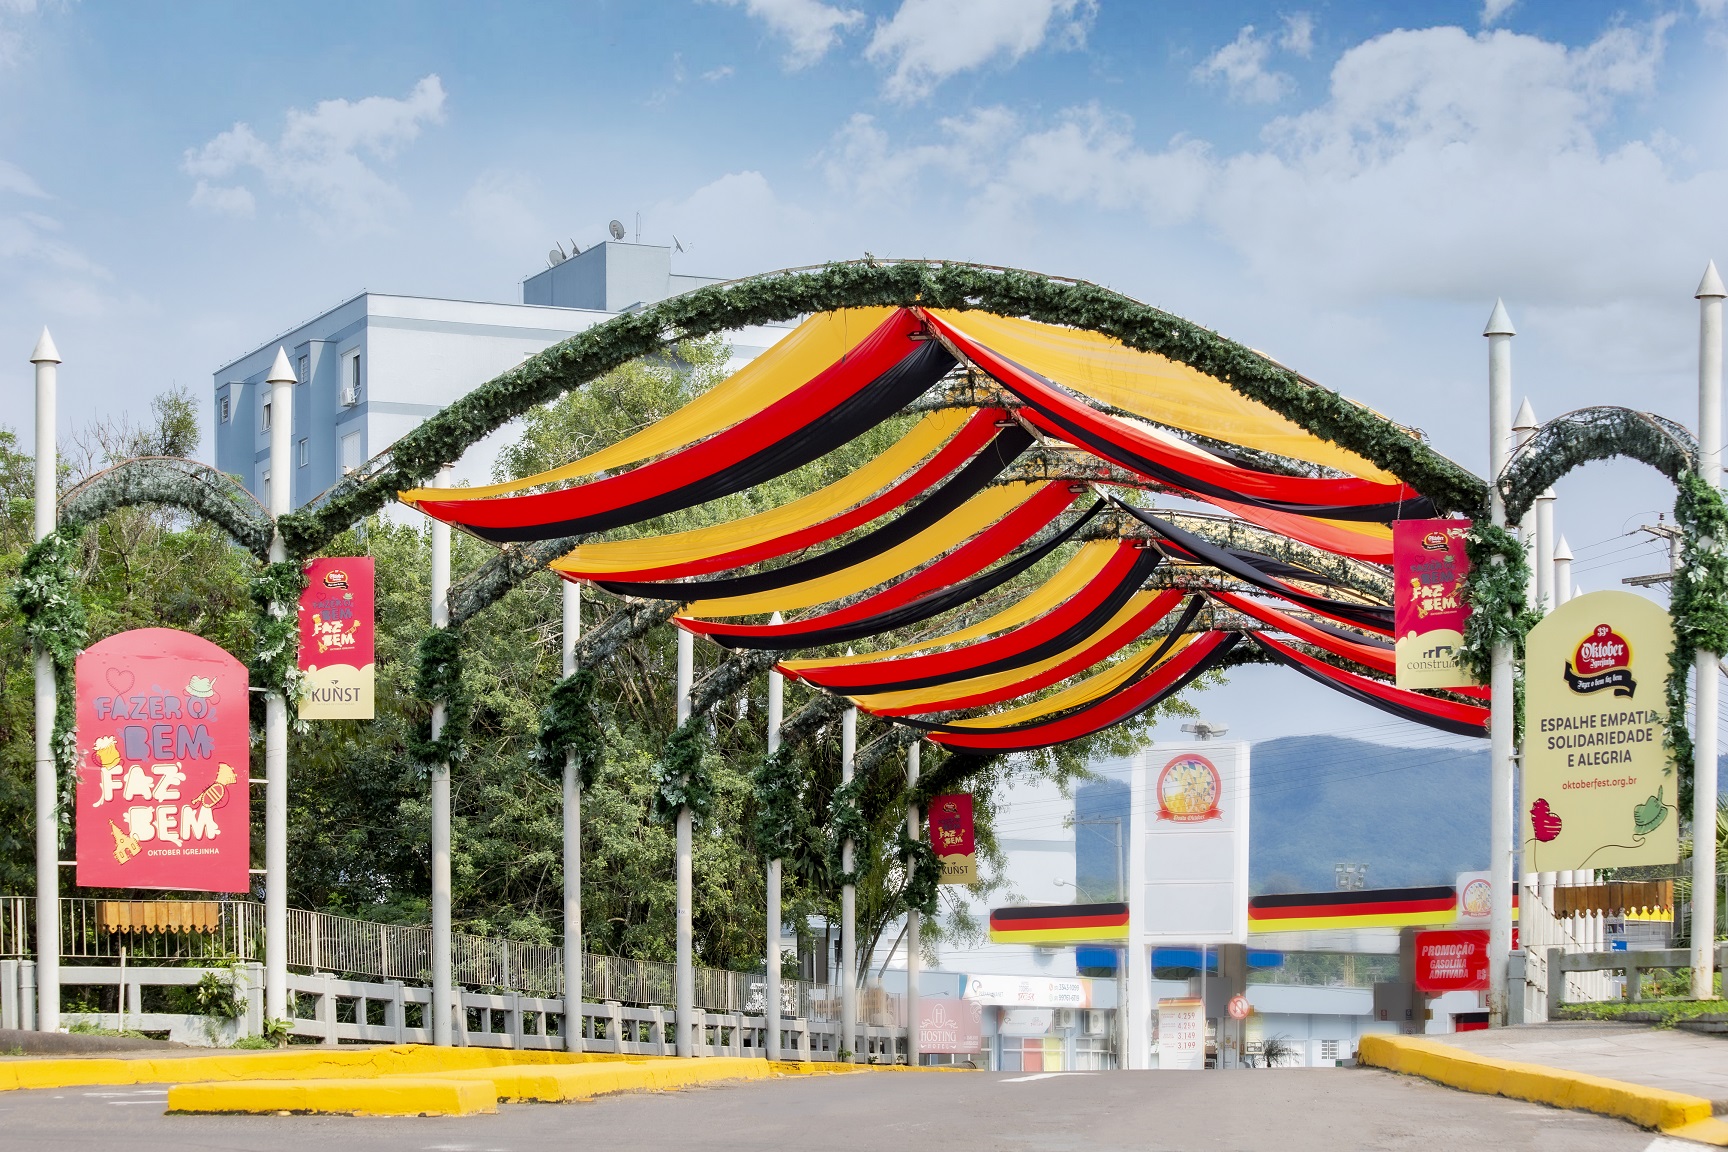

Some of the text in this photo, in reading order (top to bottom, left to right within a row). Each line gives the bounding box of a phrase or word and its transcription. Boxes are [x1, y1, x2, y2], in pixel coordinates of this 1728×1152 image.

[1410, 561, 1443, 573] FAZER
[1420, 570, 1455, 585] BEM
[1411, 584, 1445, 600] FAZ
[313, 599, 342, 609] FAZER
[1421, 597, 1458, 611] BEM
[321, 608, 353, 621] BEM
[313, 621, 344, 635] FAZ
[321, 633, 356, 646] BEM
[1581, 641, 1624, 662] Oktober
[96, 695, 209, 721] FAZER O
[1540, 710, 1653, 733] ESPALHE EMPATI
[122, 723, 214, 761] BEM
[1547, 727, 1653, 750] SOLIDARIEDADE
[1567, 749, 1632, 767] E ALEGRIA
[98, 763, 185, 803] FAZ
[1562, 776, 1637, 790] oktoberfest.org.br
[125, 804, 220, 843] BEM
[939, 829, 957, 839] FAZ
[944, 836, 964, 845] BEM
[147, 847, 220, 857] OKTOBER IGREJINHA
[1421, 942, 1475, 959] PROMOÇÃO
[1429, 958, 1467, 969] GASOLINA
[1428, 968, 1469, 980] ADITIVADA
[920, 1030, 957, 1042] HOSTING
[1177, 1041, 1196, 1050] 3.199
